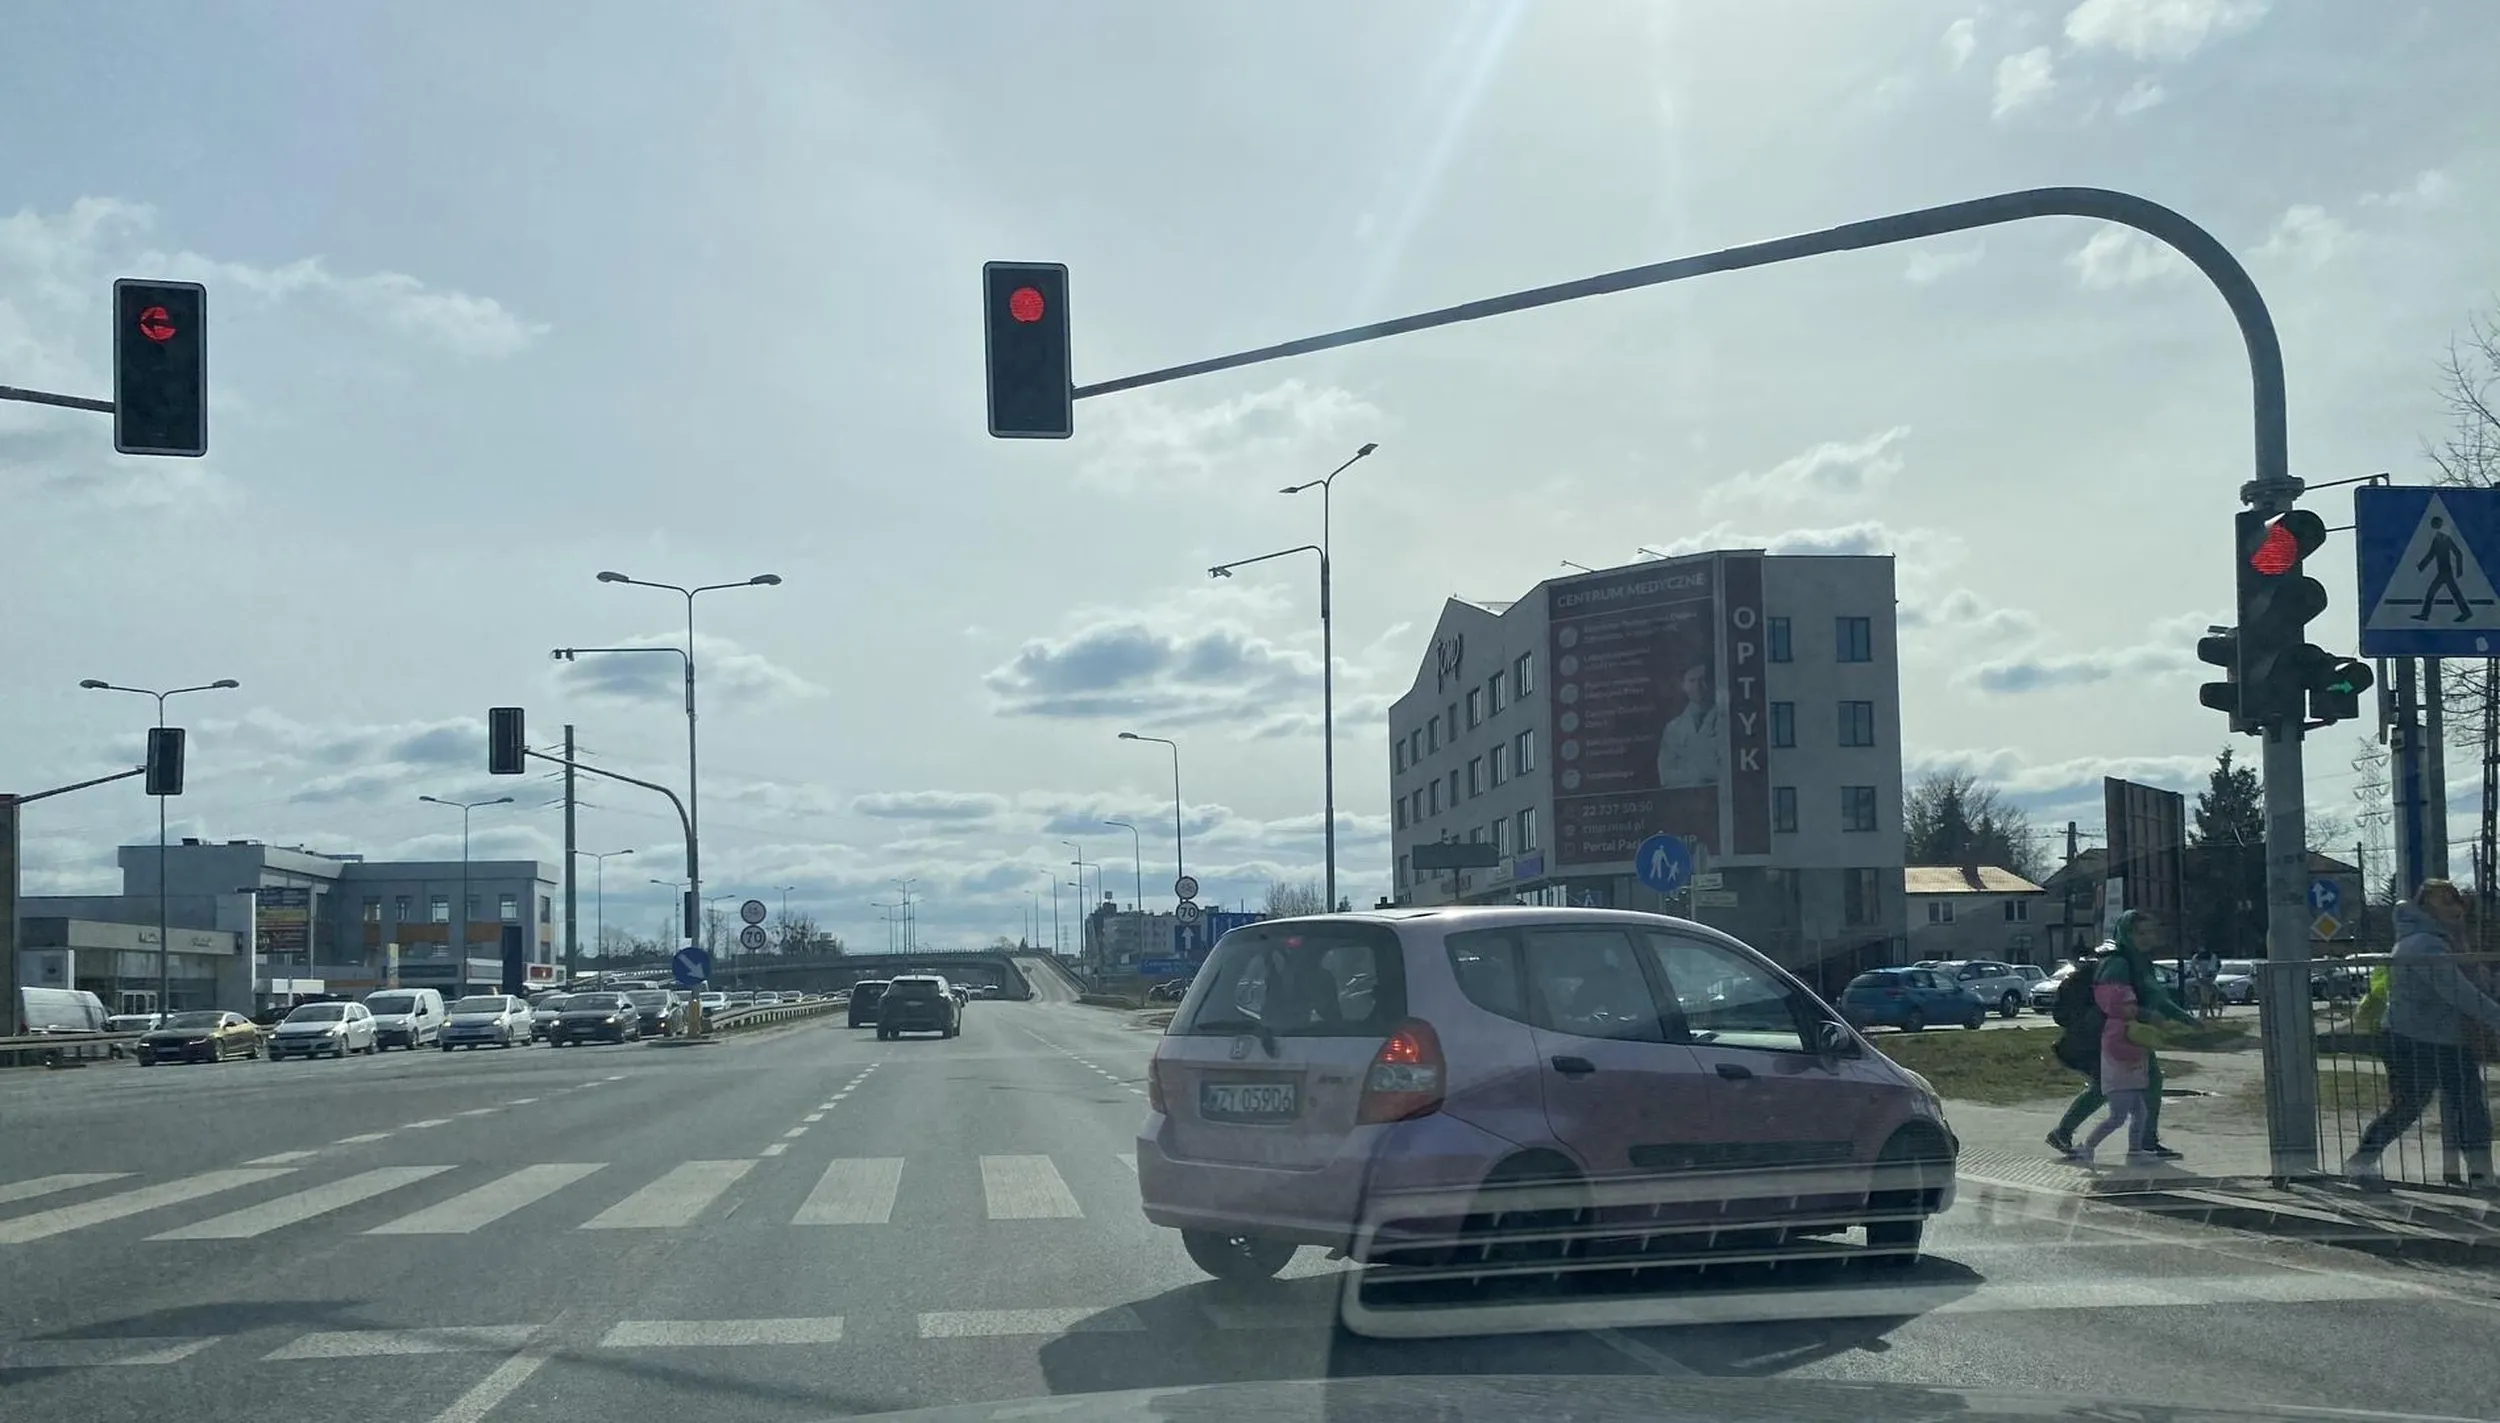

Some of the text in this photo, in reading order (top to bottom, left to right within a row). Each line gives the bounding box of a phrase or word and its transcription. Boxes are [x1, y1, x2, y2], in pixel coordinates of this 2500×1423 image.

[1557, 573, 1706, 608] CENTRUM MEDYCZNE
[1733, 606, 1760, 772] OPTYK
[1582, 839, 1616, 854] Portal
[1180, 907, 1197, 918] 70
[745, 930, 763, 944] 70
